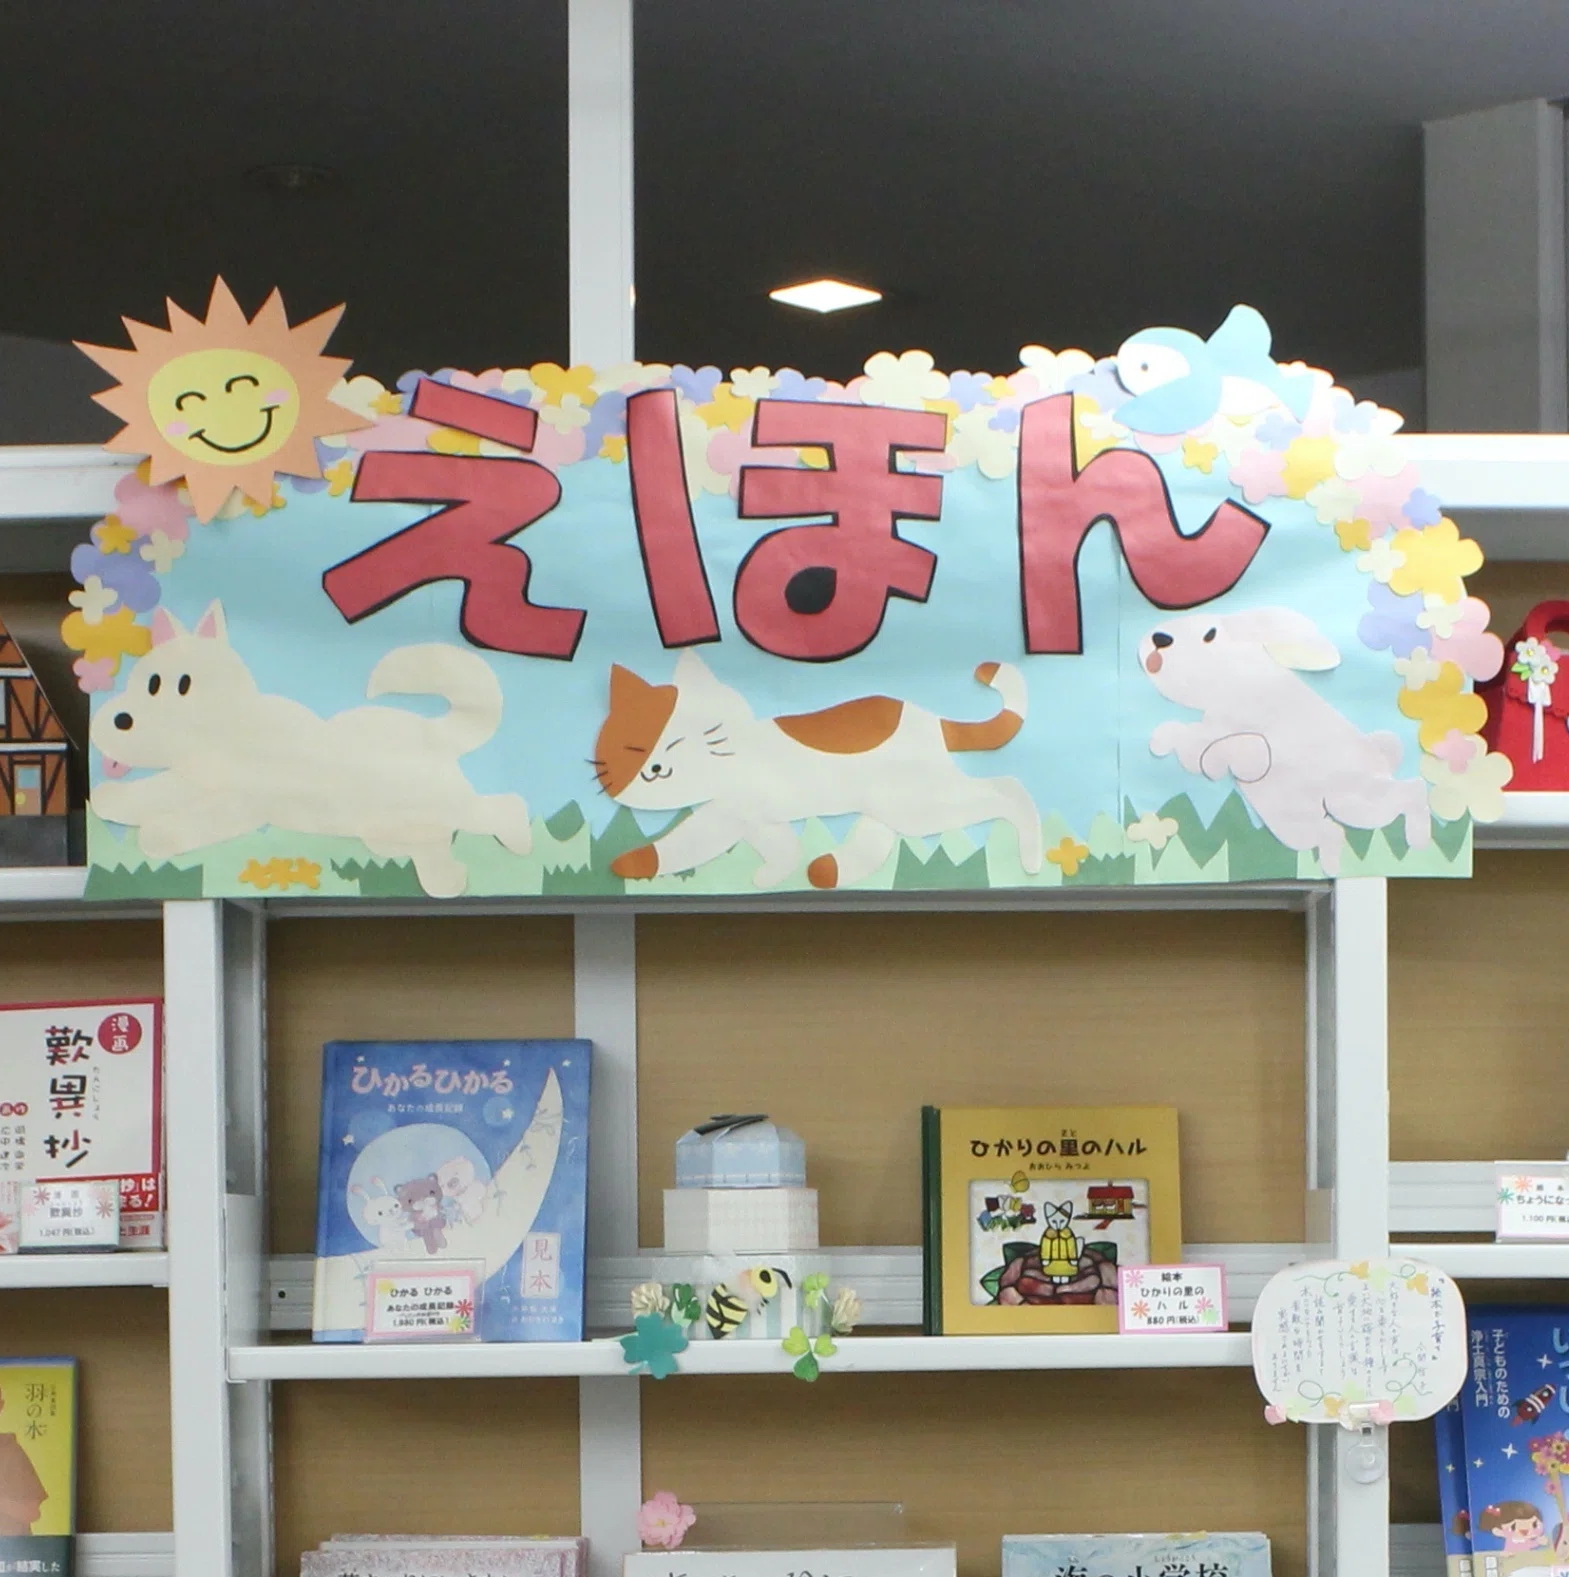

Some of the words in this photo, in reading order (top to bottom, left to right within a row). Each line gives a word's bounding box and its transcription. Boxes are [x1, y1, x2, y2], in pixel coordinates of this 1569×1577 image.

[322, 376, 1270, 662] えほん
[109, 1015, 130, 1052] 漫画
[43, 1025, 94, 1169] 歎異抄
[351, 1064, 514, 1097] ひかるひかる
[969, 1137, 1148, 1158] ひかりの里のハル
[528, 1238, 552, 1292] 見本
[1140, 1285, 1205, 1297] ひかりの里の
[1492, 1329, 1511, 1420] 子どものための
[24, 1382, 48, 1441] 羽の水
